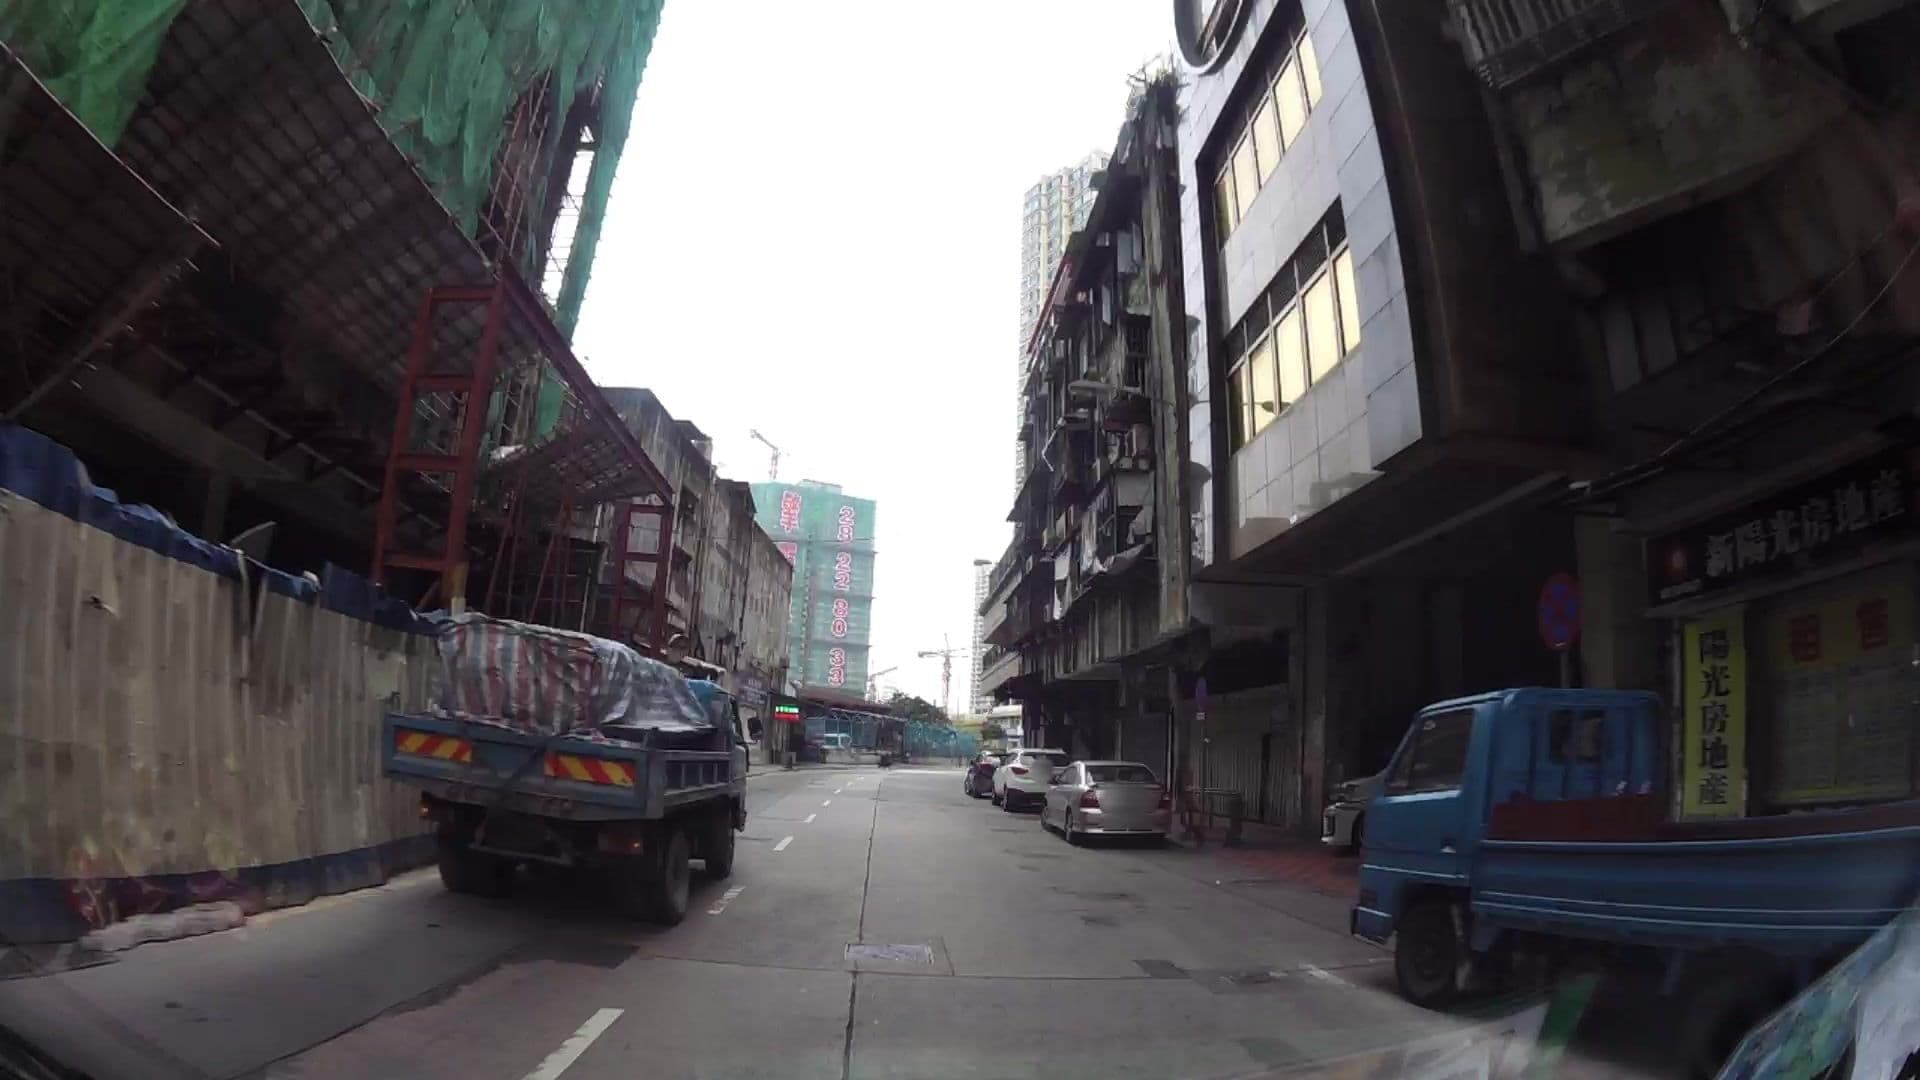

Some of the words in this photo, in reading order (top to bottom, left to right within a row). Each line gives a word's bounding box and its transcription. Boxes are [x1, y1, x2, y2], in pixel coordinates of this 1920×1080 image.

[1699, 629, 1731, 805] 陽光房地產
